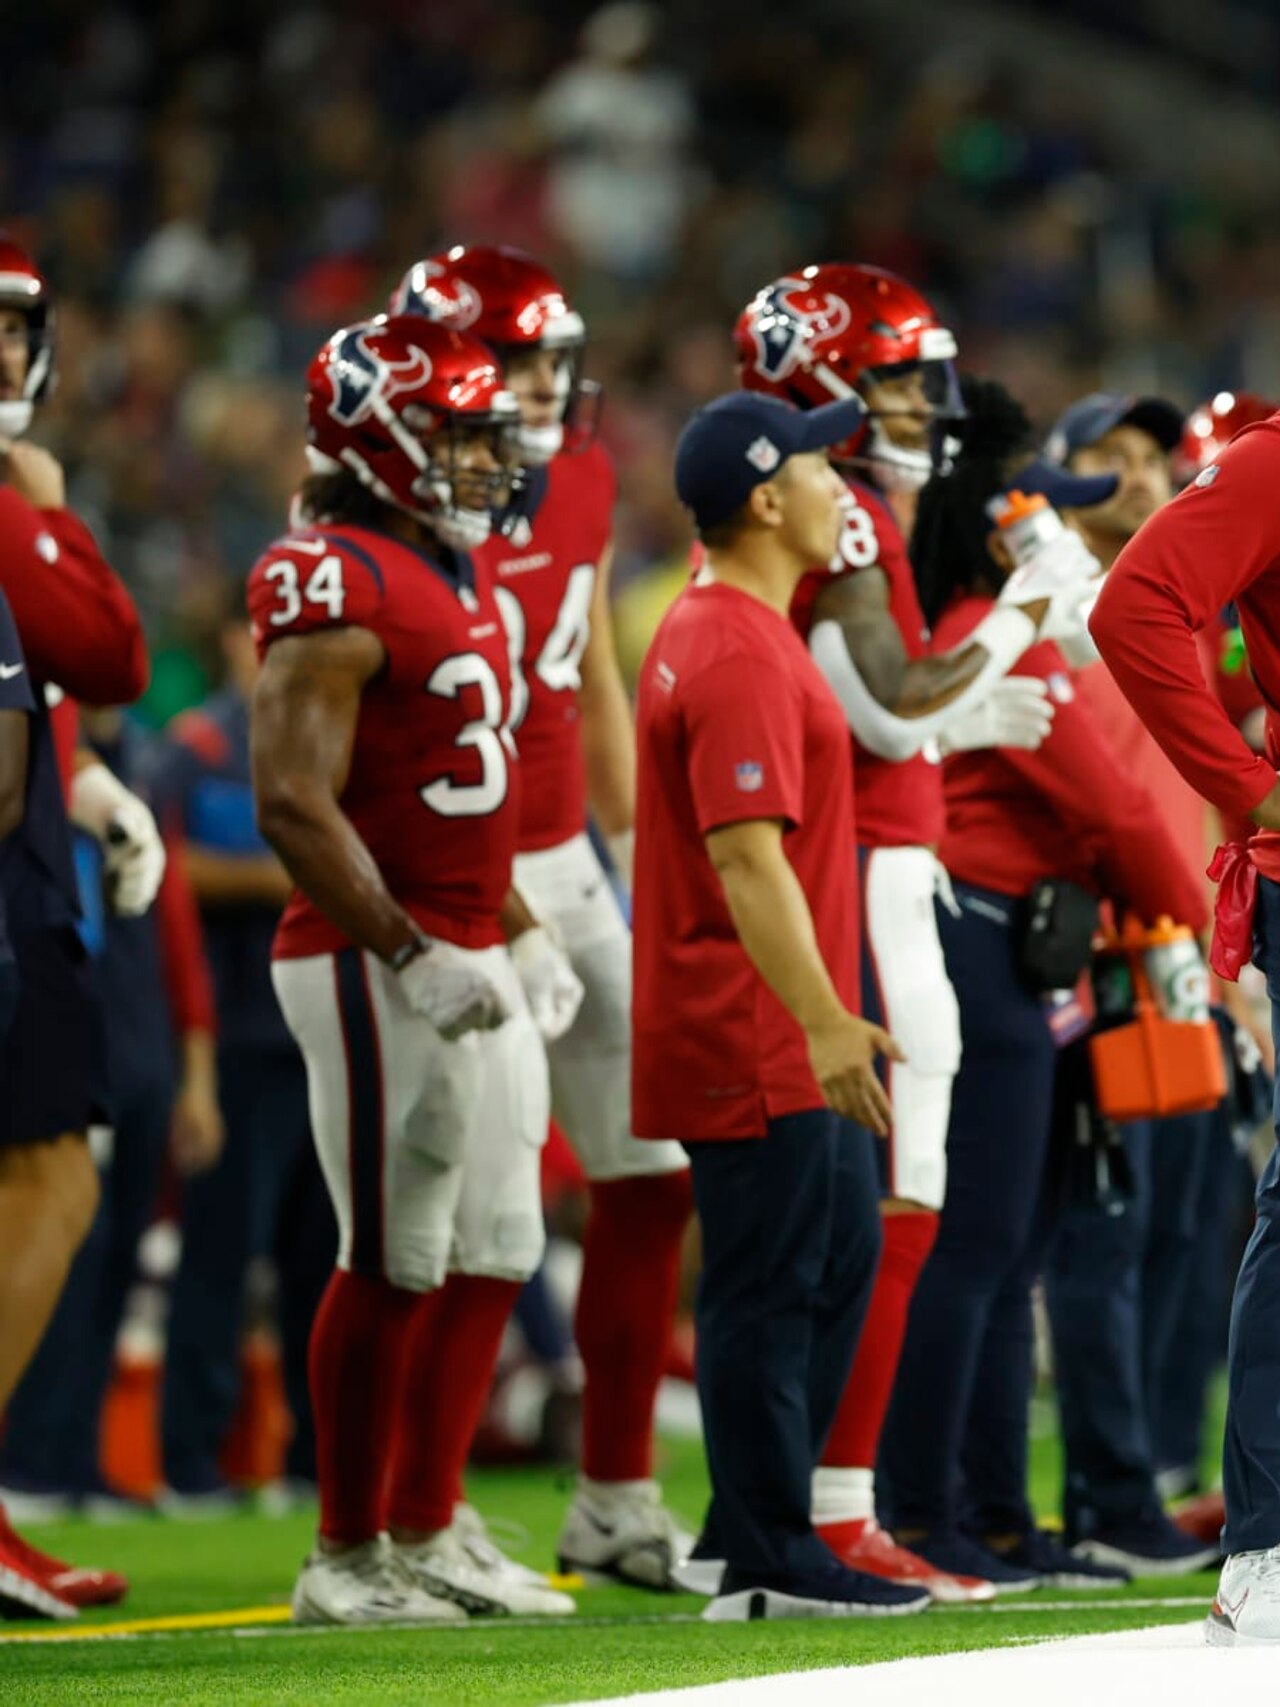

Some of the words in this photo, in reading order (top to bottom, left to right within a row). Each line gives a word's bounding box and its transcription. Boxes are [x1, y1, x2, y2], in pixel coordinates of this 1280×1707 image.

[829, 506, 879, 573] 8
[264, 555, 346, 626] 34
[419, 652, 519, 817] 3
